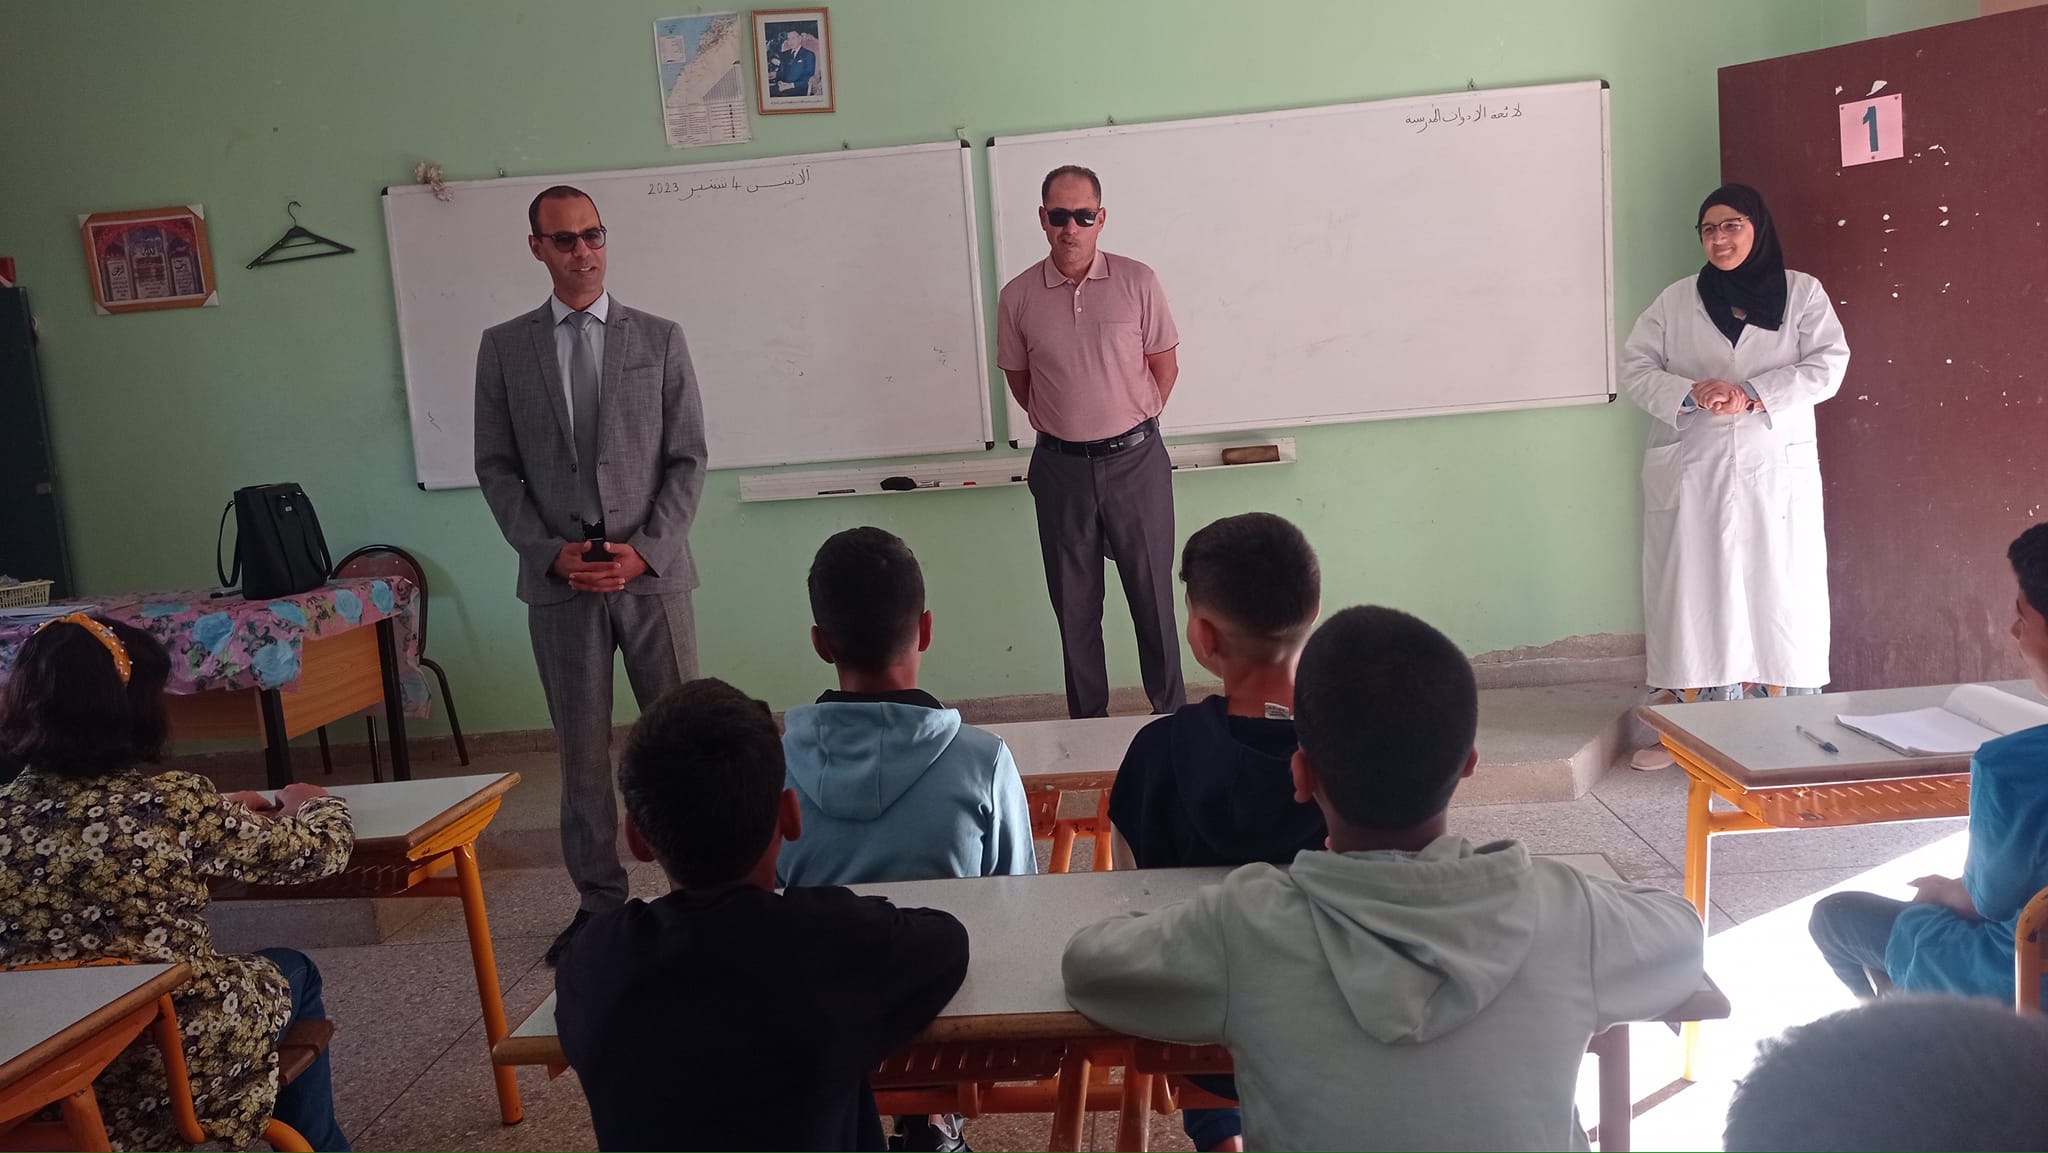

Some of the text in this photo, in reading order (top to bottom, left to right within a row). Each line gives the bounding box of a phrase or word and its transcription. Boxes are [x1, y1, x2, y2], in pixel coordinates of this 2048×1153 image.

[1862, 105, 1879, 152] 1
[647, 182, 680, 195] 2023
[732, 175, 742, 191] 4
